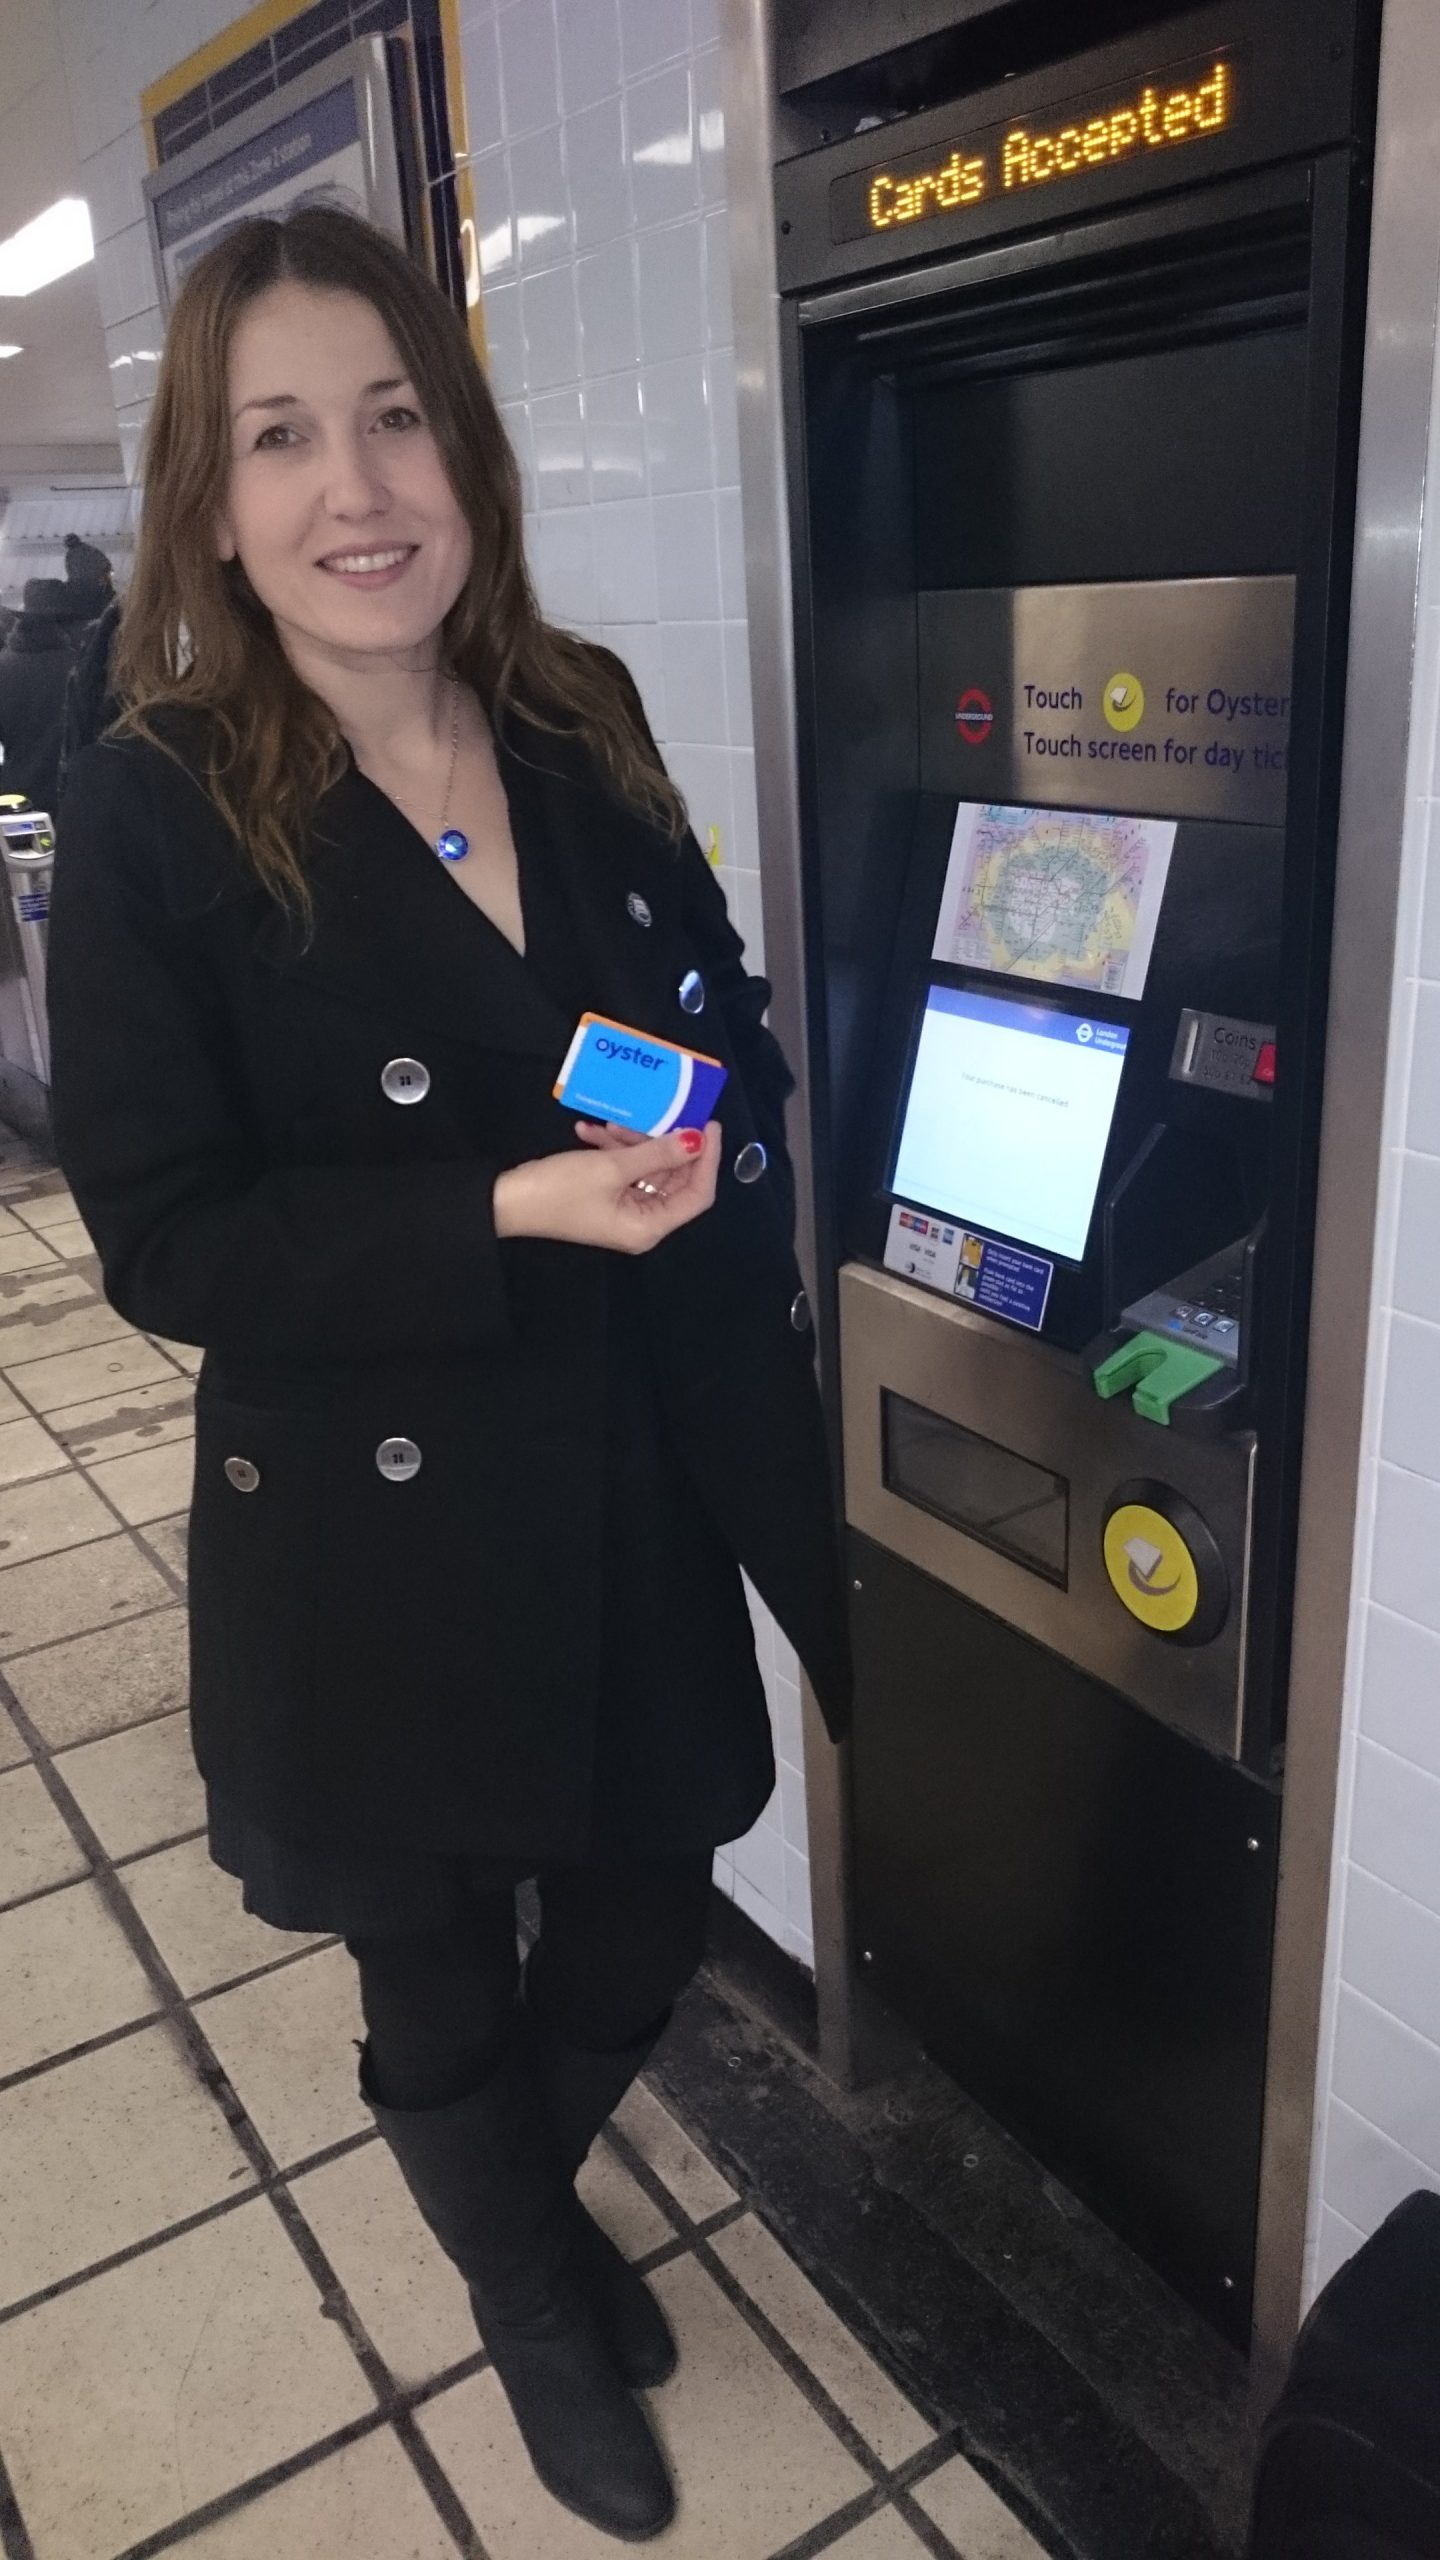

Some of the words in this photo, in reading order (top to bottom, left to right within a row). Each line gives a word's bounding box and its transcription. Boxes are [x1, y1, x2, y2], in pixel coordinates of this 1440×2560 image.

[870, 152, 984, 228] Cards
[1003, 63, 1225, 188] Accepted
[954, 711, 993, 721] UNDERGROUND
[1023, 685, 1082, 710] Touch
[1166, 688, 1199, 714] for
[1206, 688, 1290, 721] Oyster
[1023, 731, 1081, 758] Touch
[1087, 740, 1156, 762] screen
[1164, 738, 1197, 765] for
[1204, 741, 1244, 773] day
[1096, 1027, 1118, 1039] London
[1214, 1027, 1256, 1050] Coins
